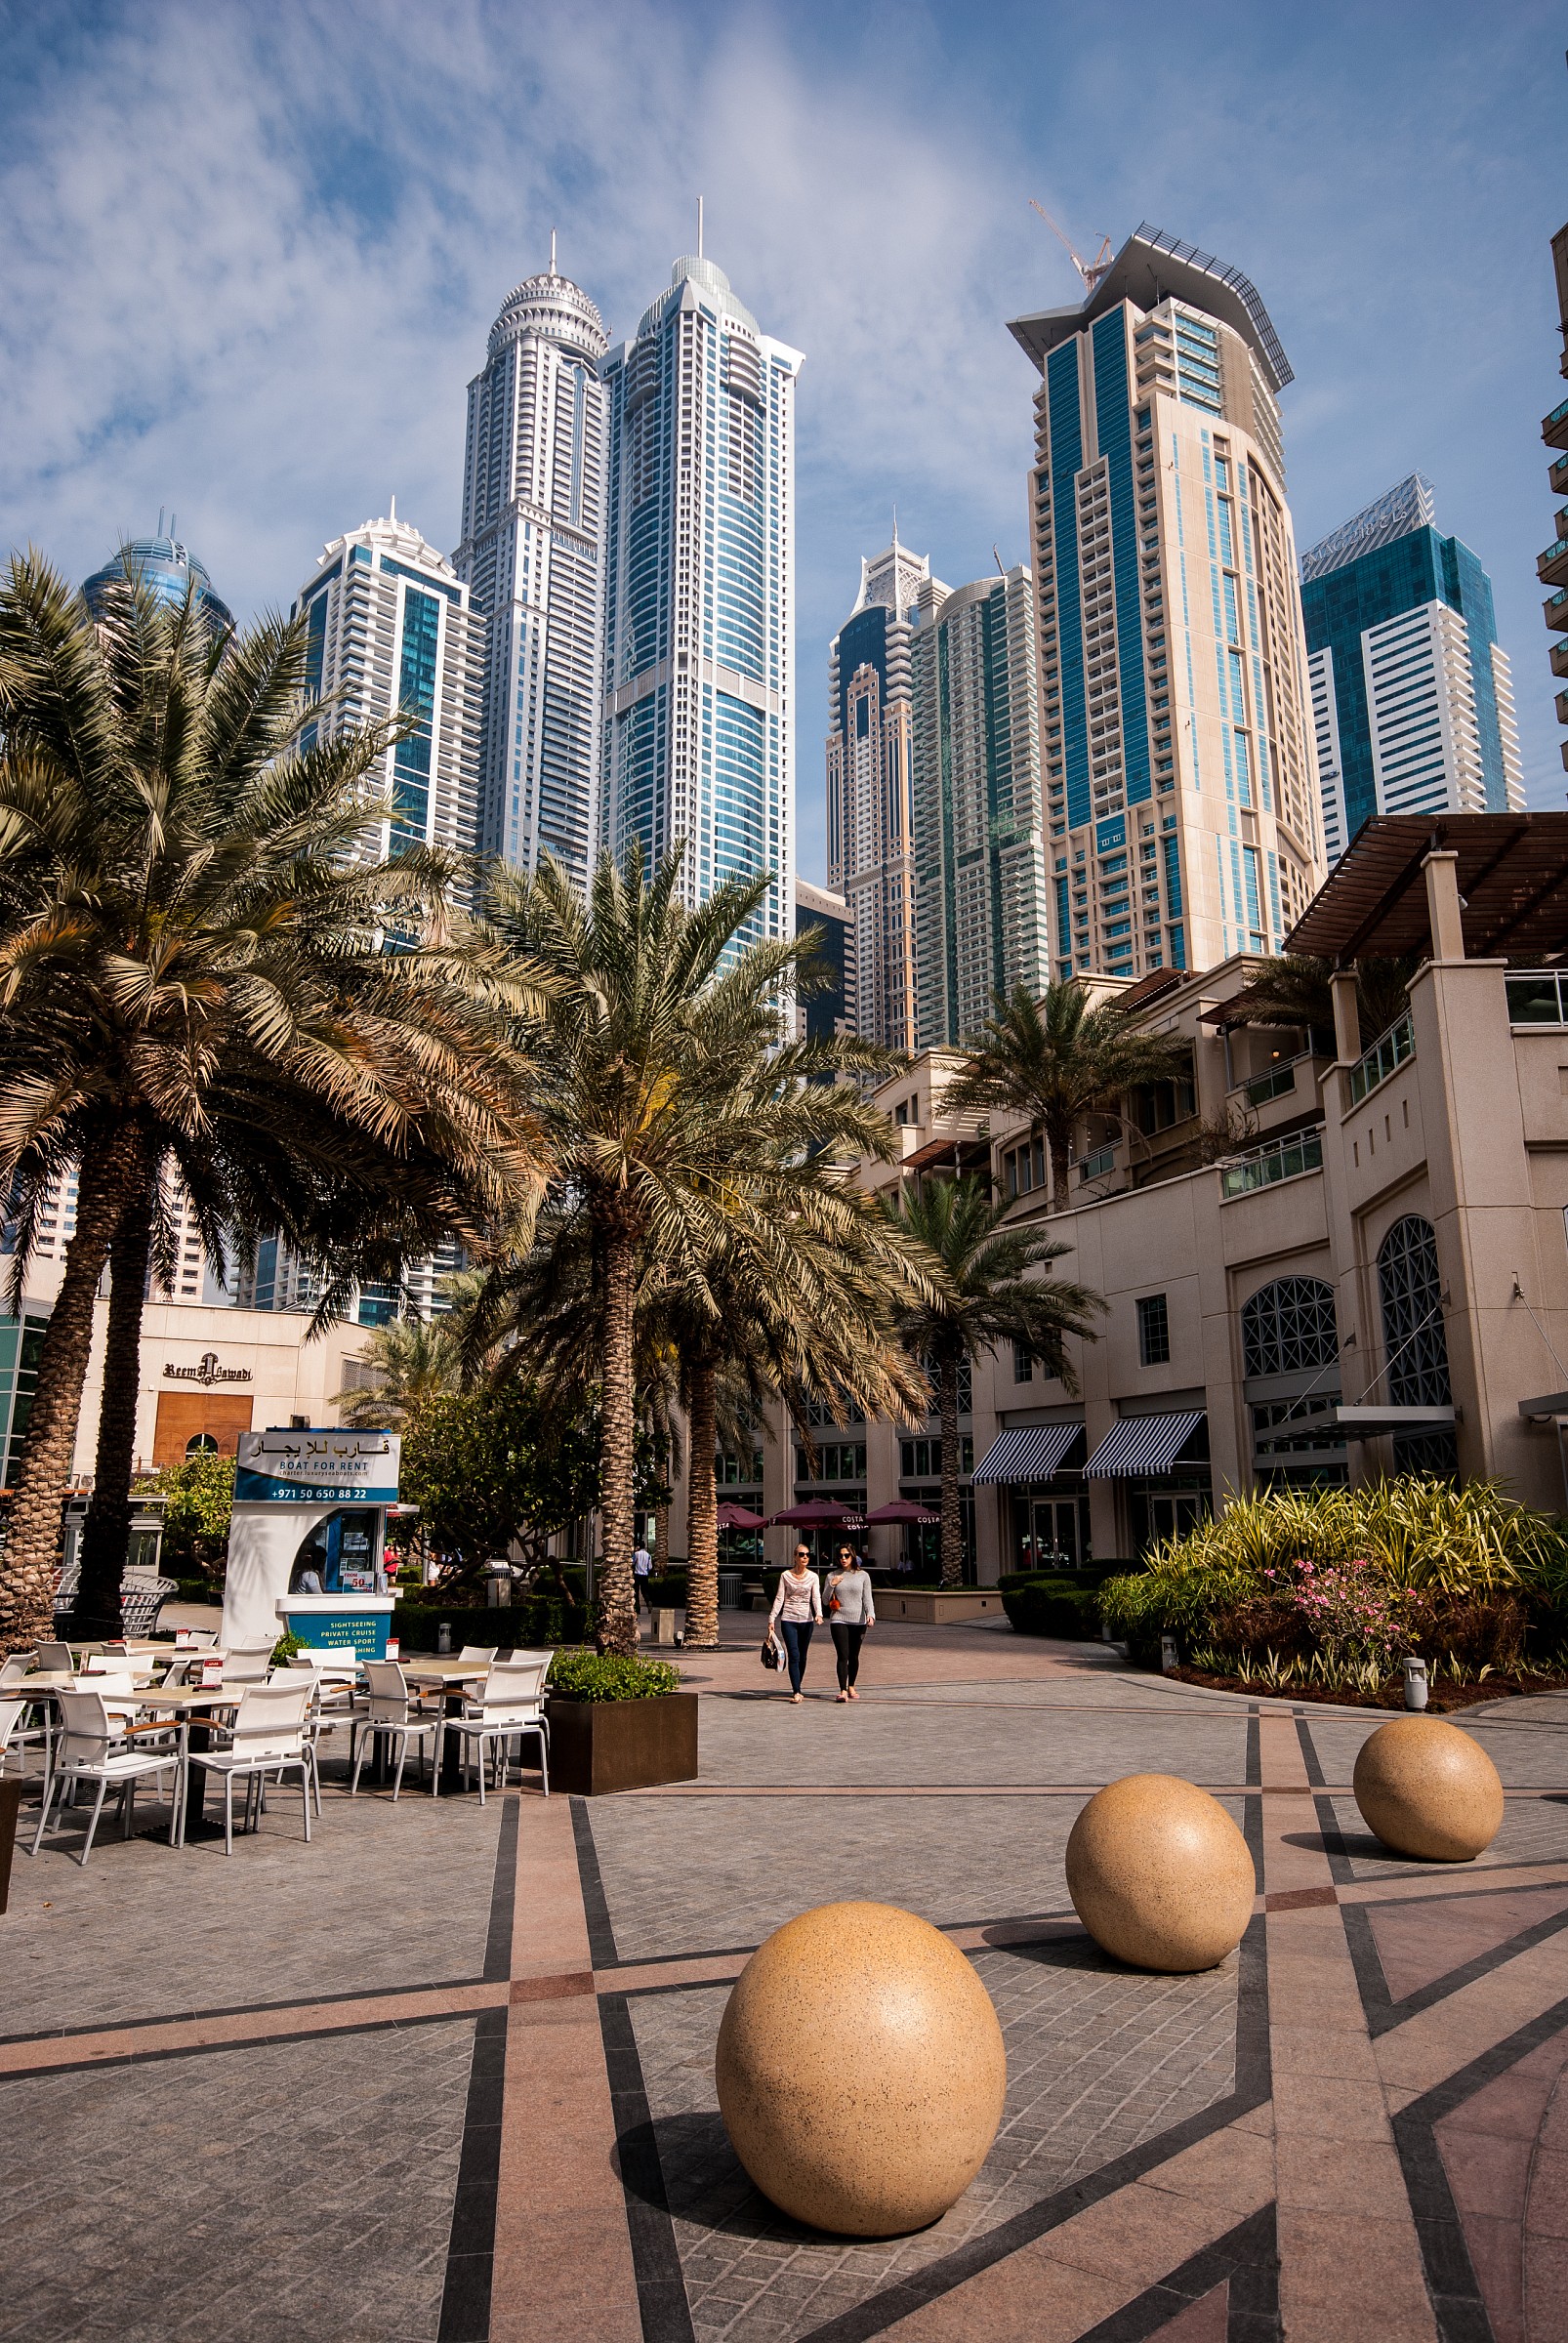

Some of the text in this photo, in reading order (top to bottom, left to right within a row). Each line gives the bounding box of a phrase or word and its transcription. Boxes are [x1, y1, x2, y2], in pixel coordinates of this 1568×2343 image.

[1350, 522, 1375, 545] 218
[163, 1363, 196, 1377] Reem
[279, 1461, 368, 1470] BOAT FOR RENT
[271, 1489, 367, 1499] +971 50 650 88 22
